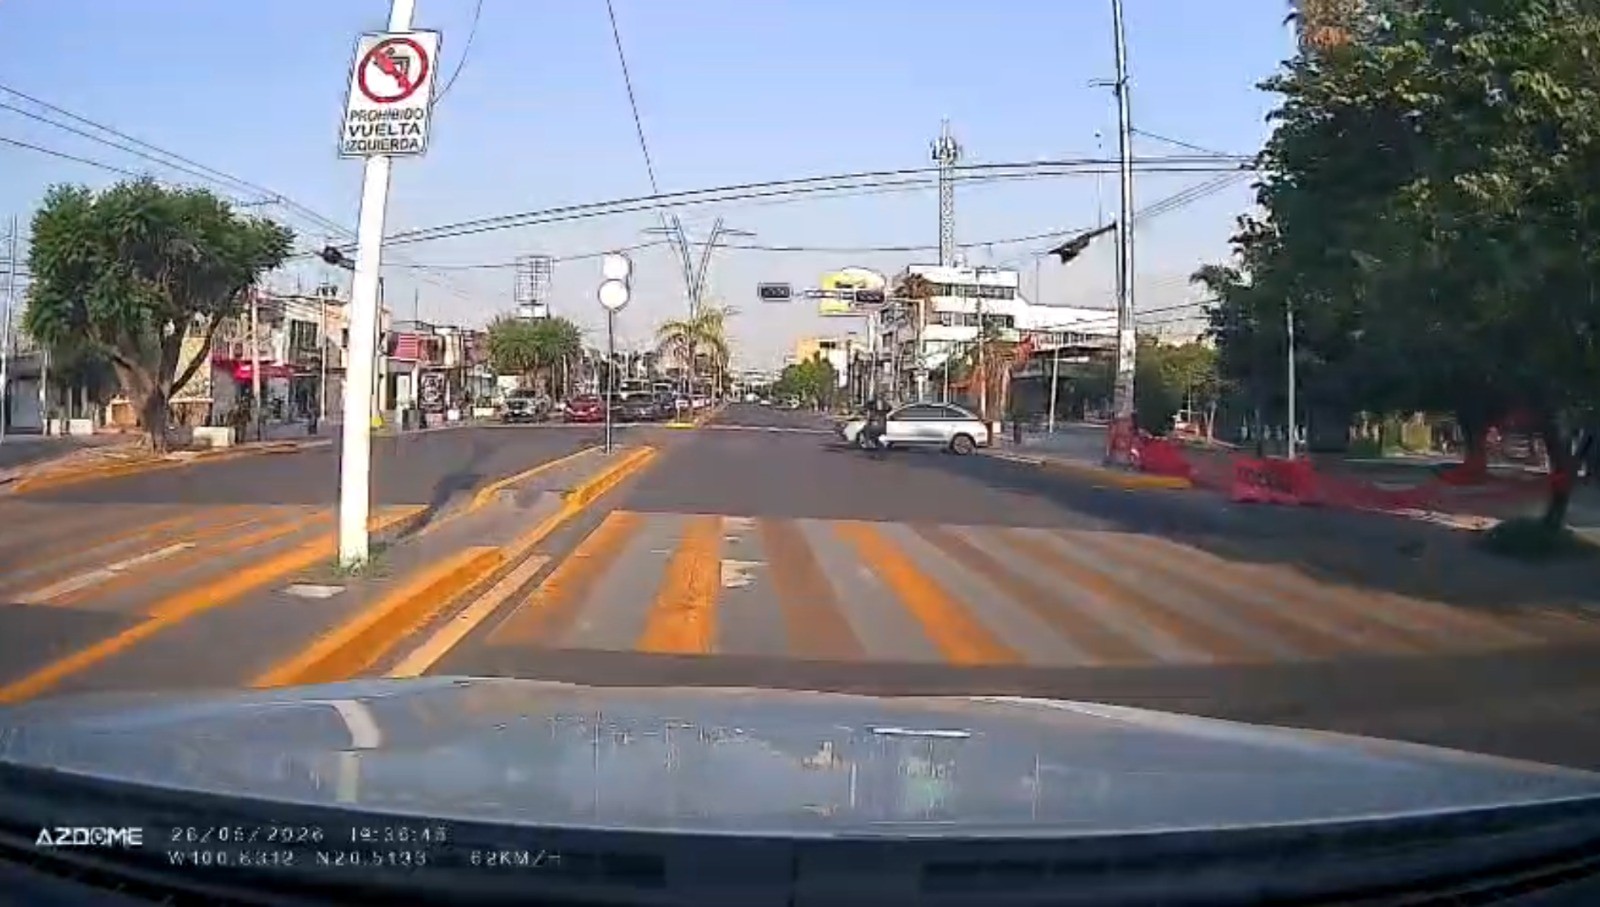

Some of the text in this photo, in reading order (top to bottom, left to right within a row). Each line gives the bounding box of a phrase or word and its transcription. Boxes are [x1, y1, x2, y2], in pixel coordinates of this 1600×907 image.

[349, 107, 424, 122] PROHIBIDO
[348, 122, 421, 137] VUELTA
[345, 138, 419, 152] IZQUIERDA
